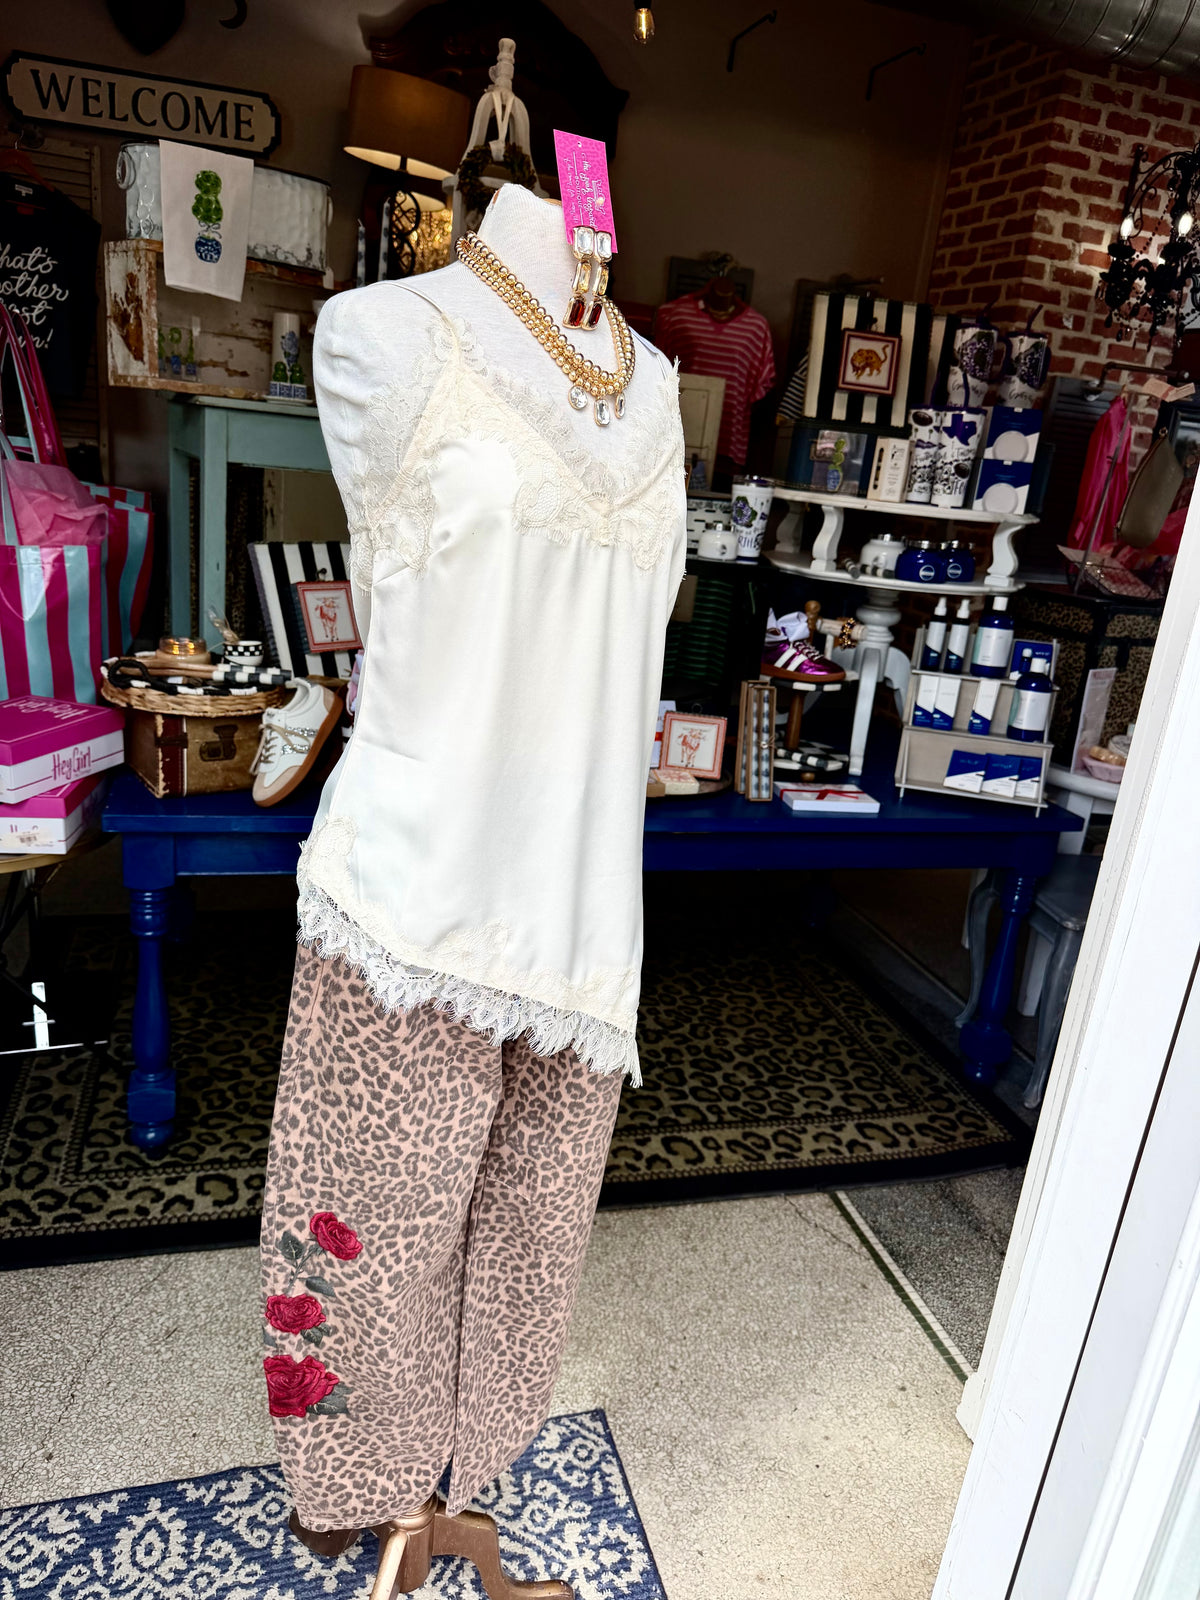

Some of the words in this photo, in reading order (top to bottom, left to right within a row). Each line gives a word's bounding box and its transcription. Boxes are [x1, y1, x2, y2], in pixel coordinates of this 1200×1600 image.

[30, 69, 256, 143] WELCOME
[0, 242, 59, 274] hat's
[0, 271, 69, 301] other
